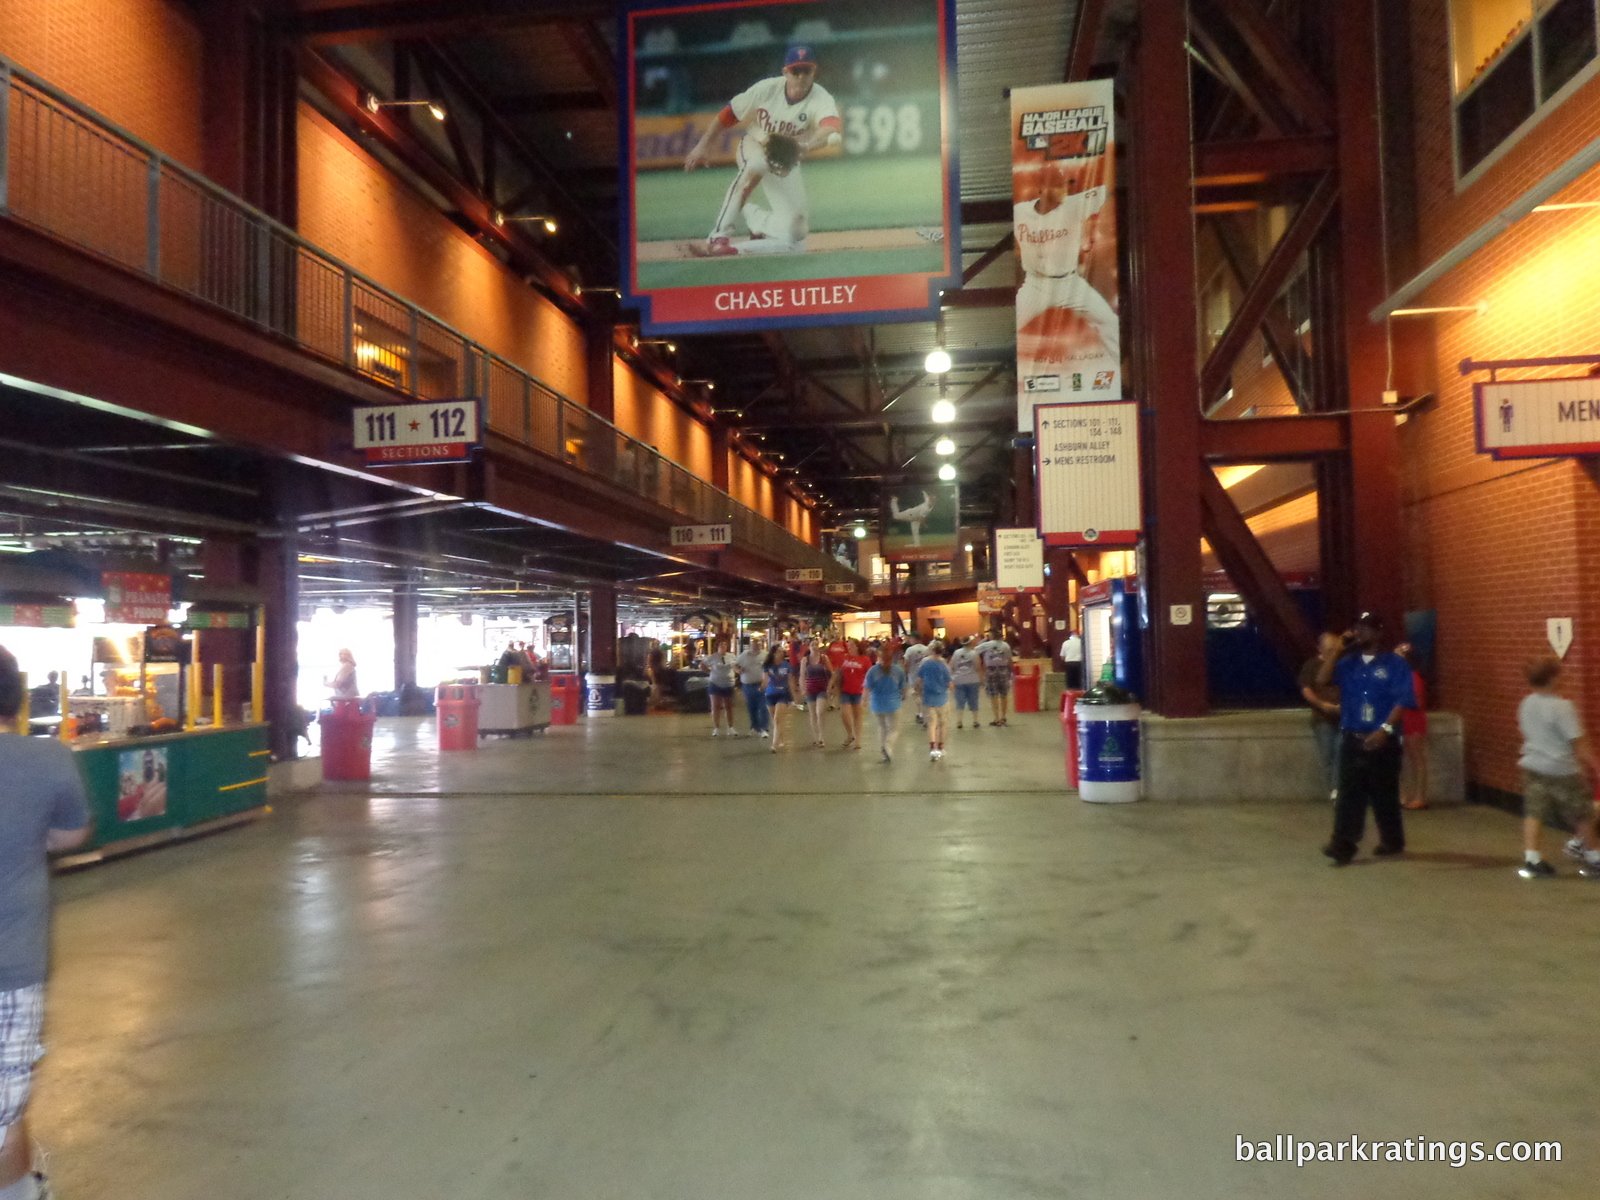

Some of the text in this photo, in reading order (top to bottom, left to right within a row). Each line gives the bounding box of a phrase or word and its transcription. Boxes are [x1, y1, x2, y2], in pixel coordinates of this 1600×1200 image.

[1023, 107, 1104, 122] MAJOR LEAGUE
[846, 104, 923, 154] 398
[1021, 117, 1108, 136] BASEBALL
[715, 285, 857, 311] CHASE UTLEY
[1065, 353, 1104, 361] HALLADAY
[1027, 379, 1035, 389] E
[365, 407, 466, 441] 111 112
[1053, 419, 1088, 429] SECTIONS
[382, 445, 449, 459] SECTIONS
[1054, 441, 1110, 452] ASHBURN ALLEY
[1054, 455, 1116, 466] MENS RESTROOM
[676, 527, 725, 543] 110 111
